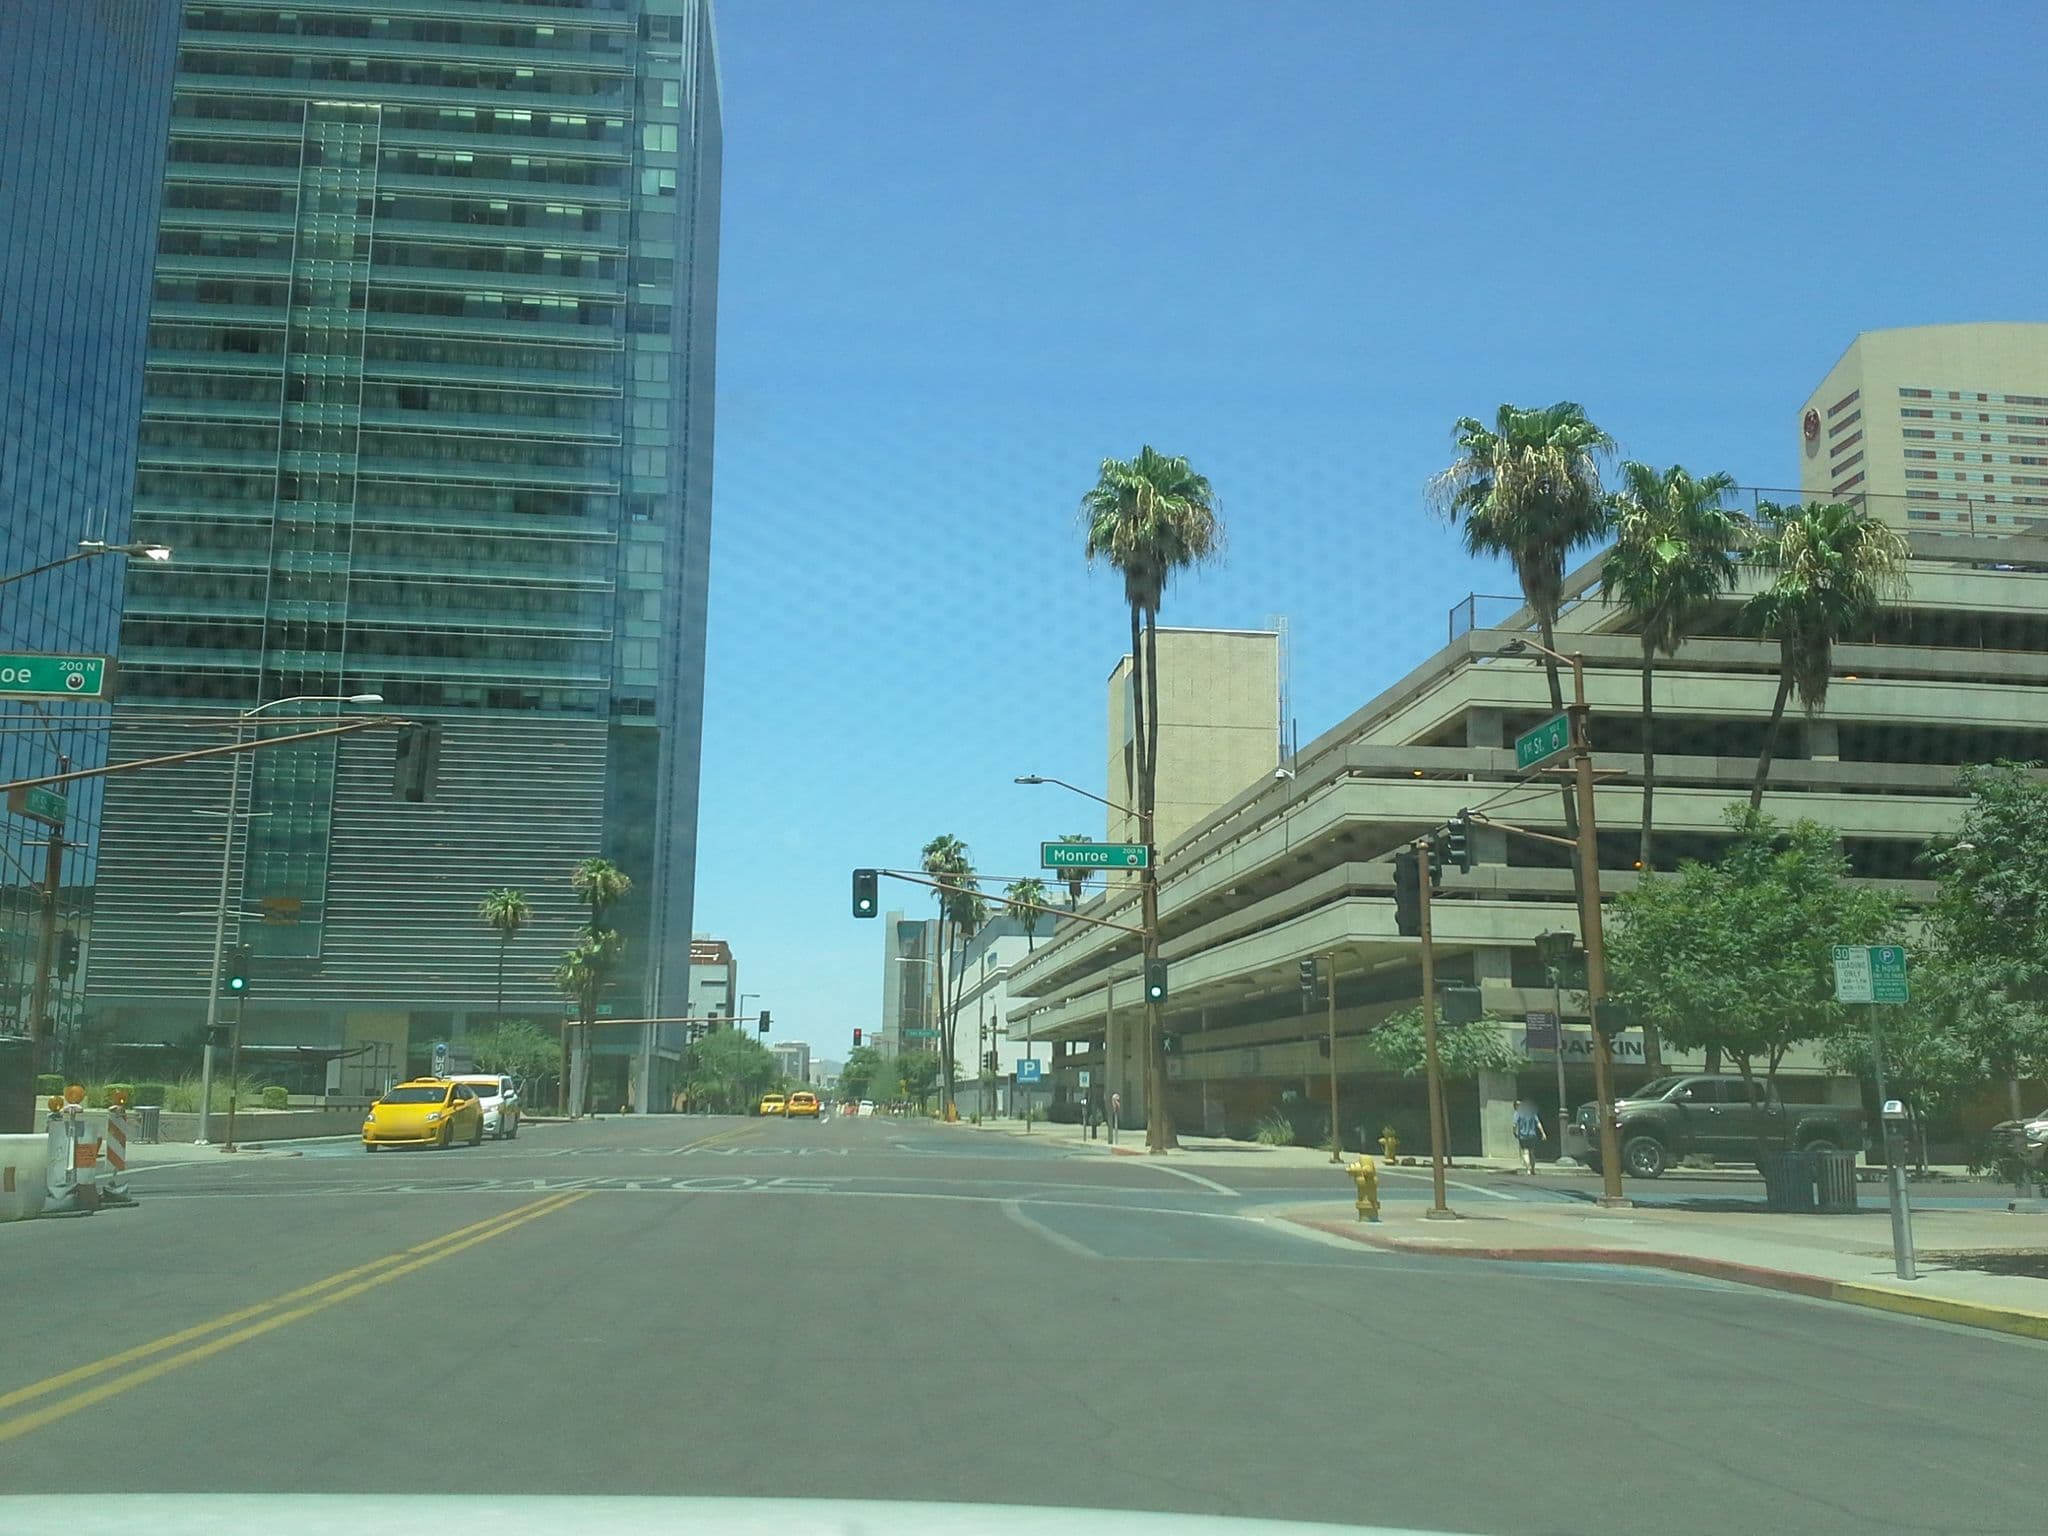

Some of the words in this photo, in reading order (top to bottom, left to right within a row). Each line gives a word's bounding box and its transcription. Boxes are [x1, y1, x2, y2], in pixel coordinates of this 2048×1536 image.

[59, 661, 83, 671] 200
[86, 662, 96, 671] N
[1054, 849, 1108, 861] Monroe
[1835, 948, 1849, 960] 30
[1024, 1061, 1035, 1076] P
